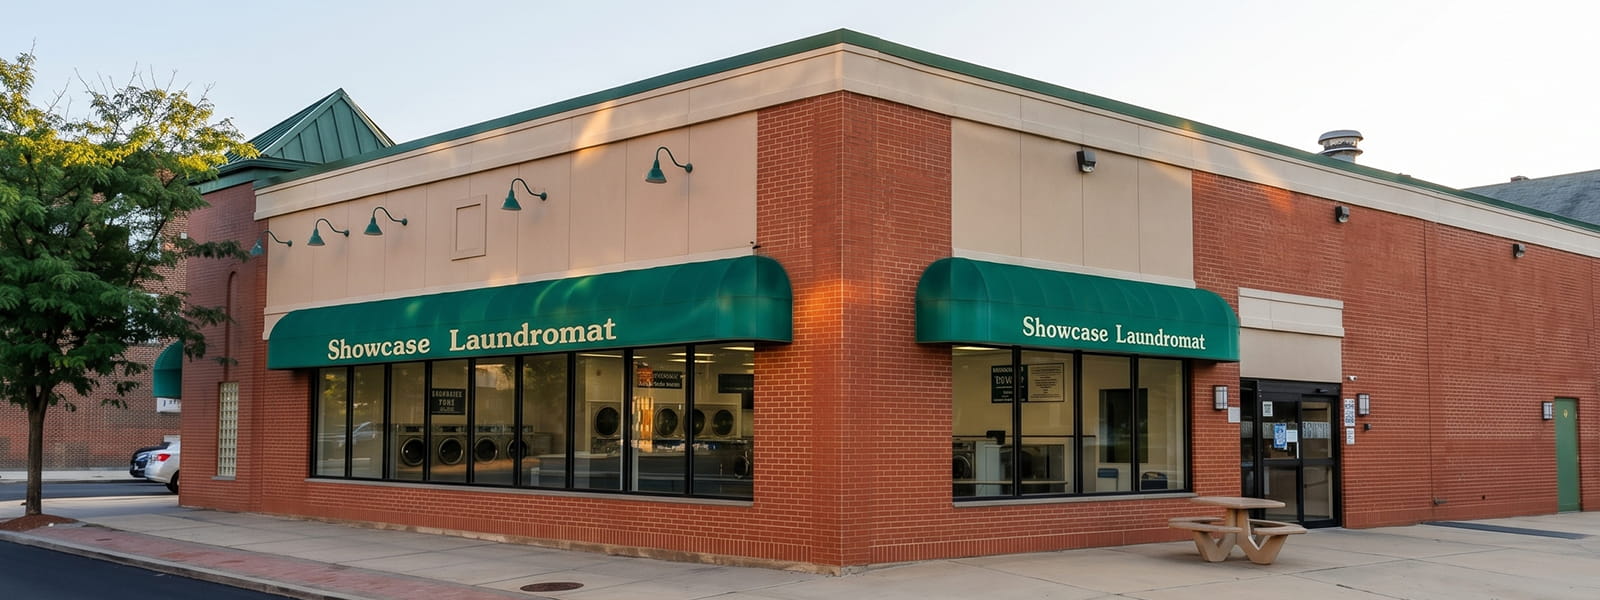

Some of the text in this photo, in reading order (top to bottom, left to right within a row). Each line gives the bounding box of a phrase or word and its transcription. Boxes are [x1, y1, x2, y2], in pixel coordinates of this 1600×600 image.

[327, 318, 616, 360] Showcase Laundromat
[1022, 316, 1206, 350] Showcase Laundromat
